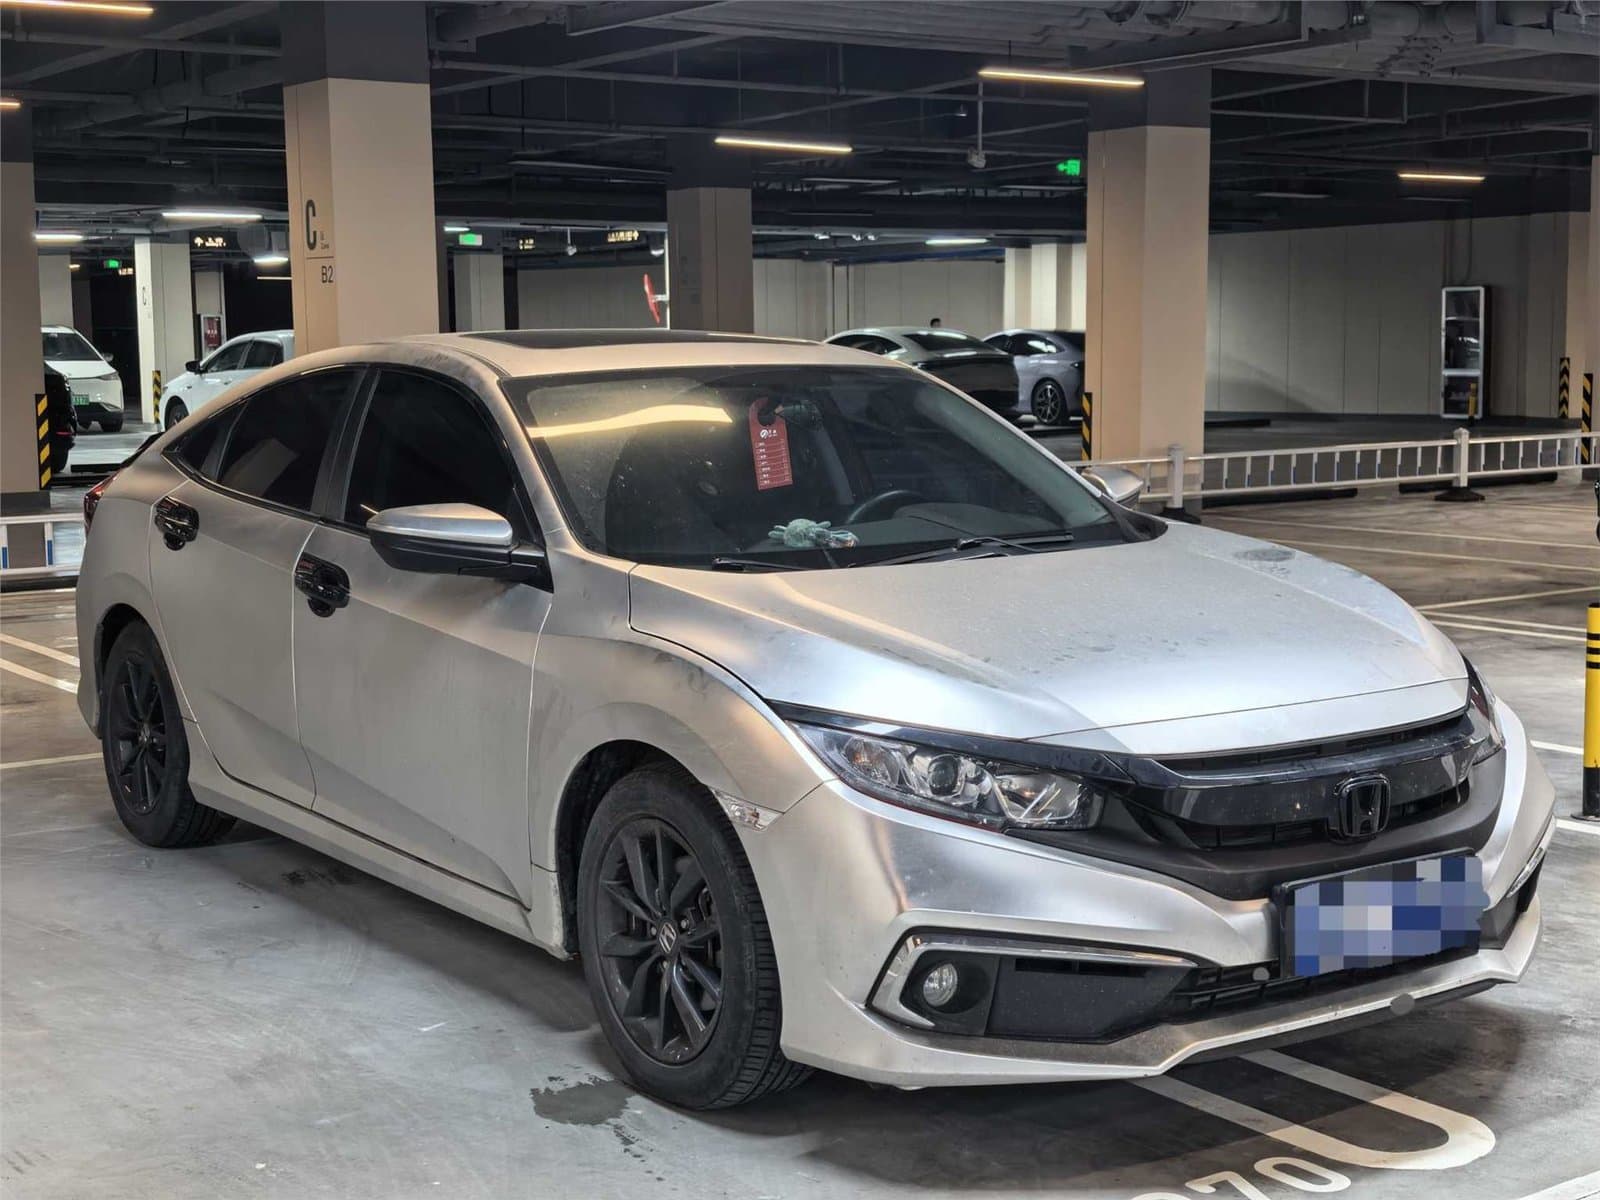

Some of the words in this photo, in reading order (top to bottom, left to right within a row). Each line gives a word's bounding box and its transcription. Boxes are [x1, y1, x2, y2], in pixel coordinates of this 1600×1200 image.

[306, 199, 317, 251] C
[321, 265, 334, 284] B2
[1128, 1156, 1352, 1200] 70
